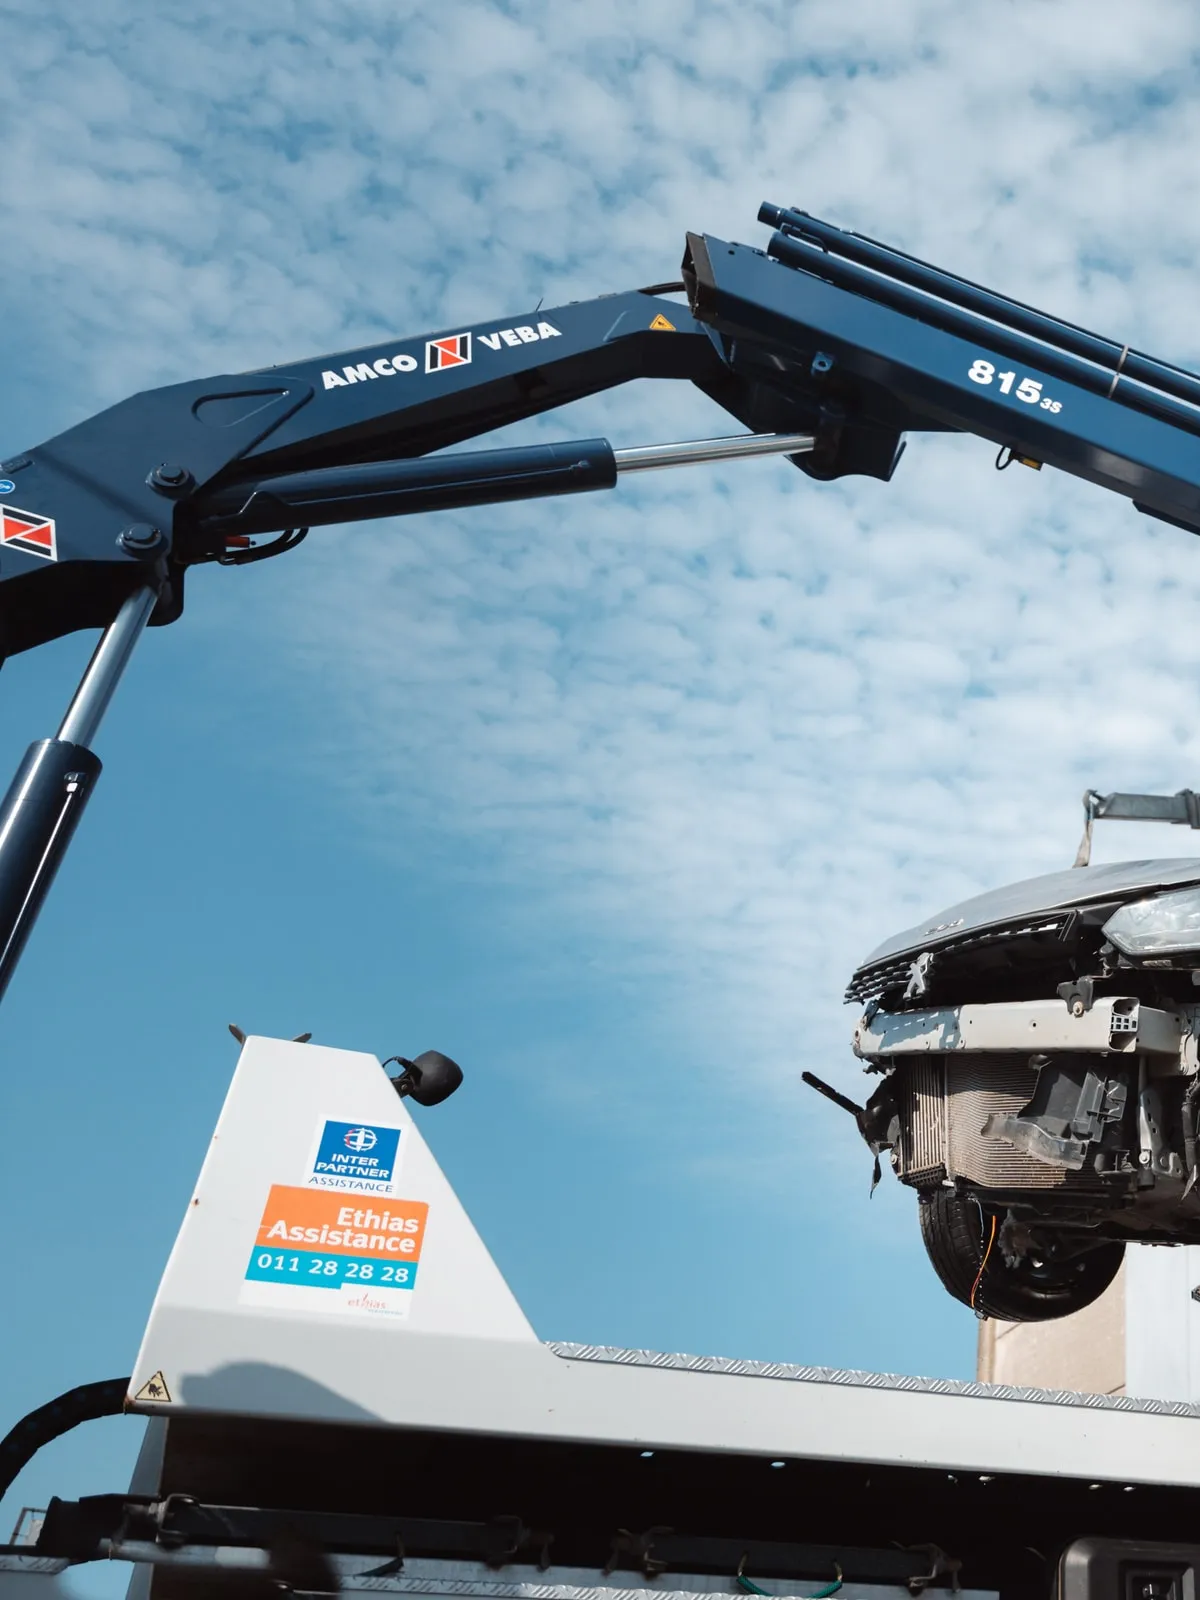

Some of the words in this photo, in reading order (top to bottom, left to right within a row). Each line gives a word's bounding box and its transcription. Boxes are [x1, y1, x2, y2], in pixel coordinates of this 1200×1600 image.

[321, 354, 418, 390] AMCO
[477, 322, 562, 350] VEBA
[315, 1162, 390, 1178] PARTNER
[331, 1153, 379, 1167] INTER
[308, 1176, 394, 1193] ASSISTANCE
[336, 1207, 419, 1233] Ethias
[267, 1220, 416, 1253] Assistance
[257, 1253, 300, 1272] 011
[308, 1259, 338, 1275] 28
[345, 1263, 374, 1279] 28
[380, 1266, 409, 1283] 28
